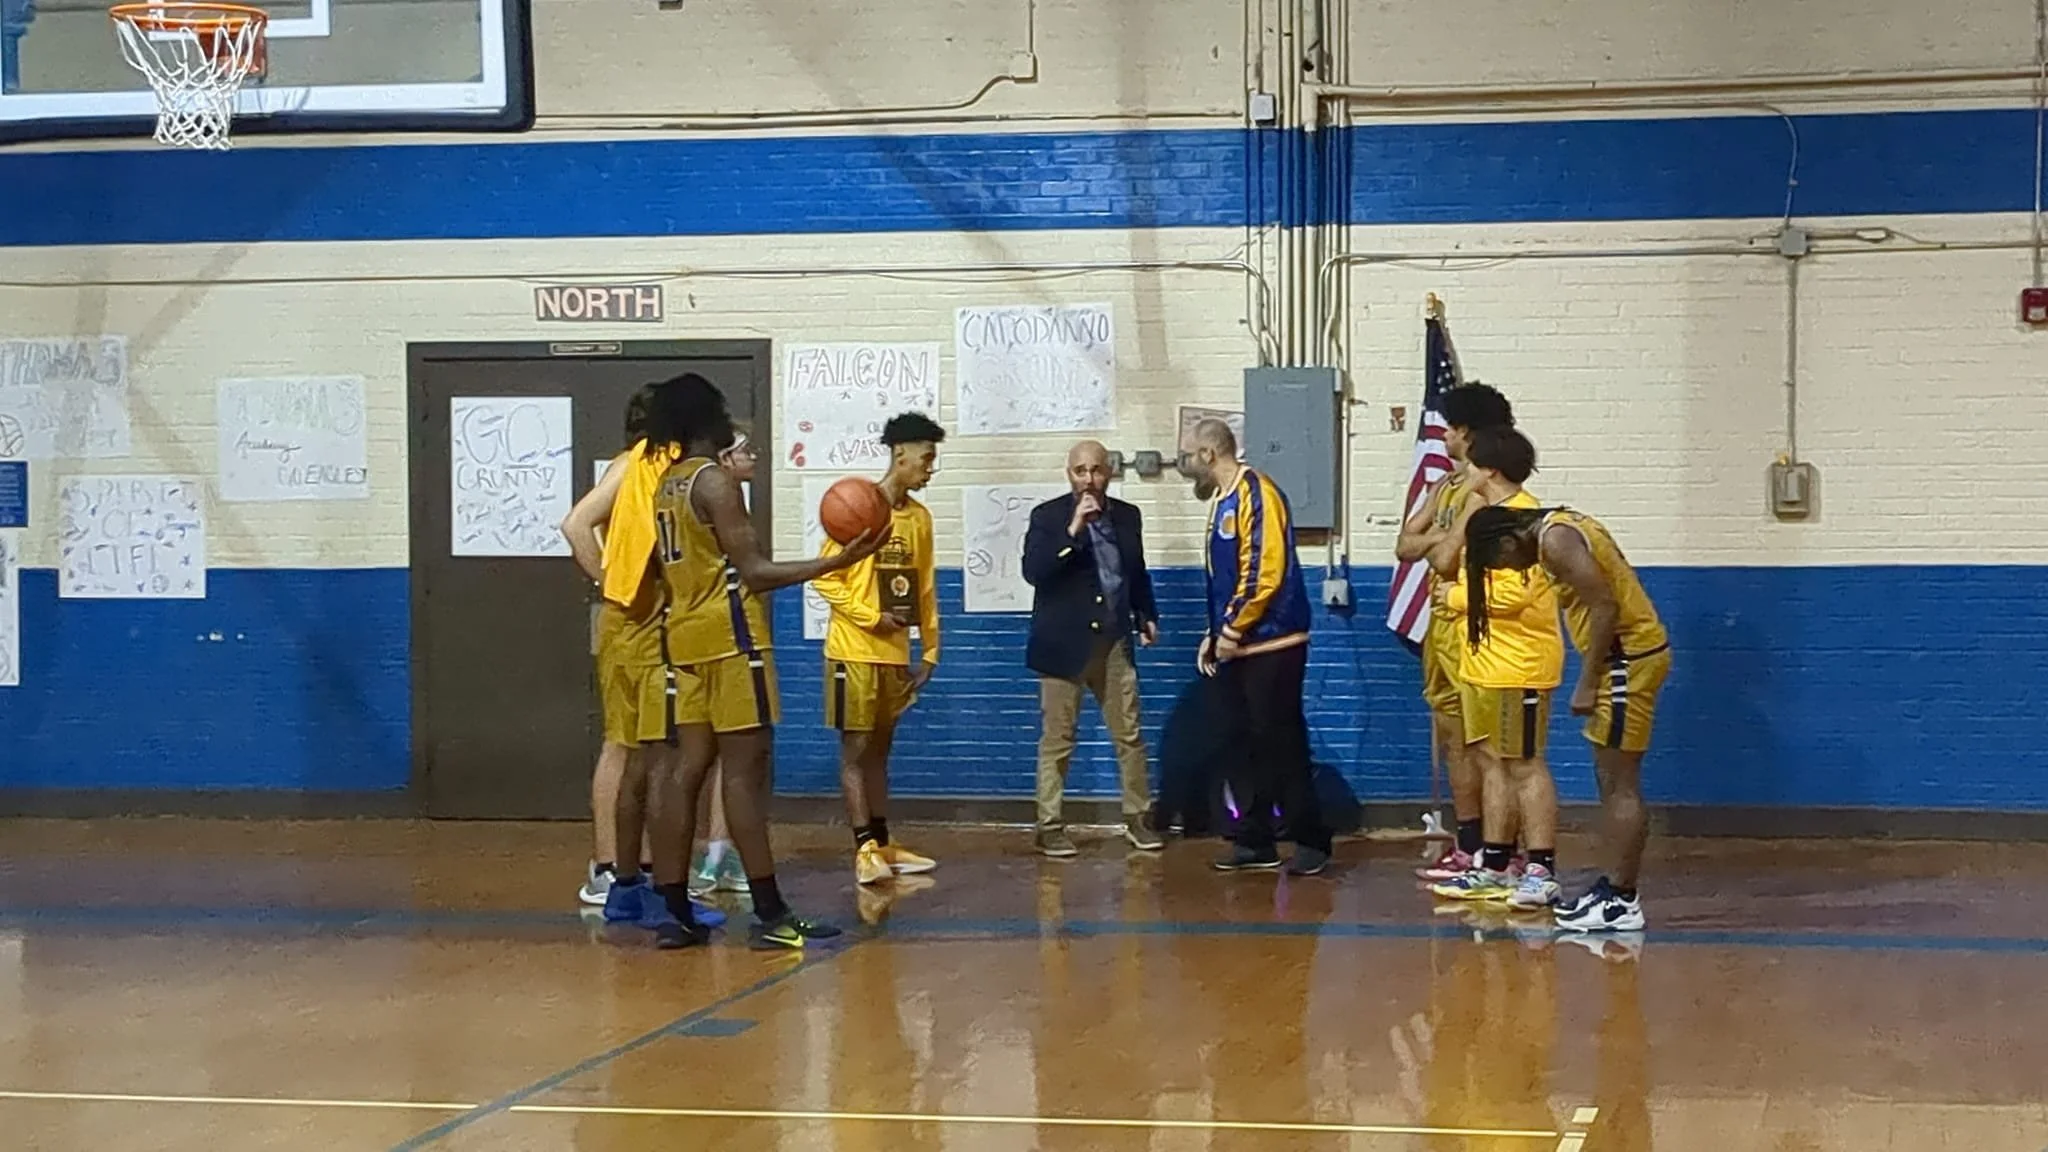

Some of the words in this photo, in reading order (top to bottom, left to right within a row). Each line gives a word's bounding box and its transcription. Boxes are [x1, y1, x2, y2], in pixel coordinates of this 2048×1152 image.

[538, 286, 660, 318] NORTH
[789, 349, 928, 391] FALCON
[462, 403, 549, 464] GO
